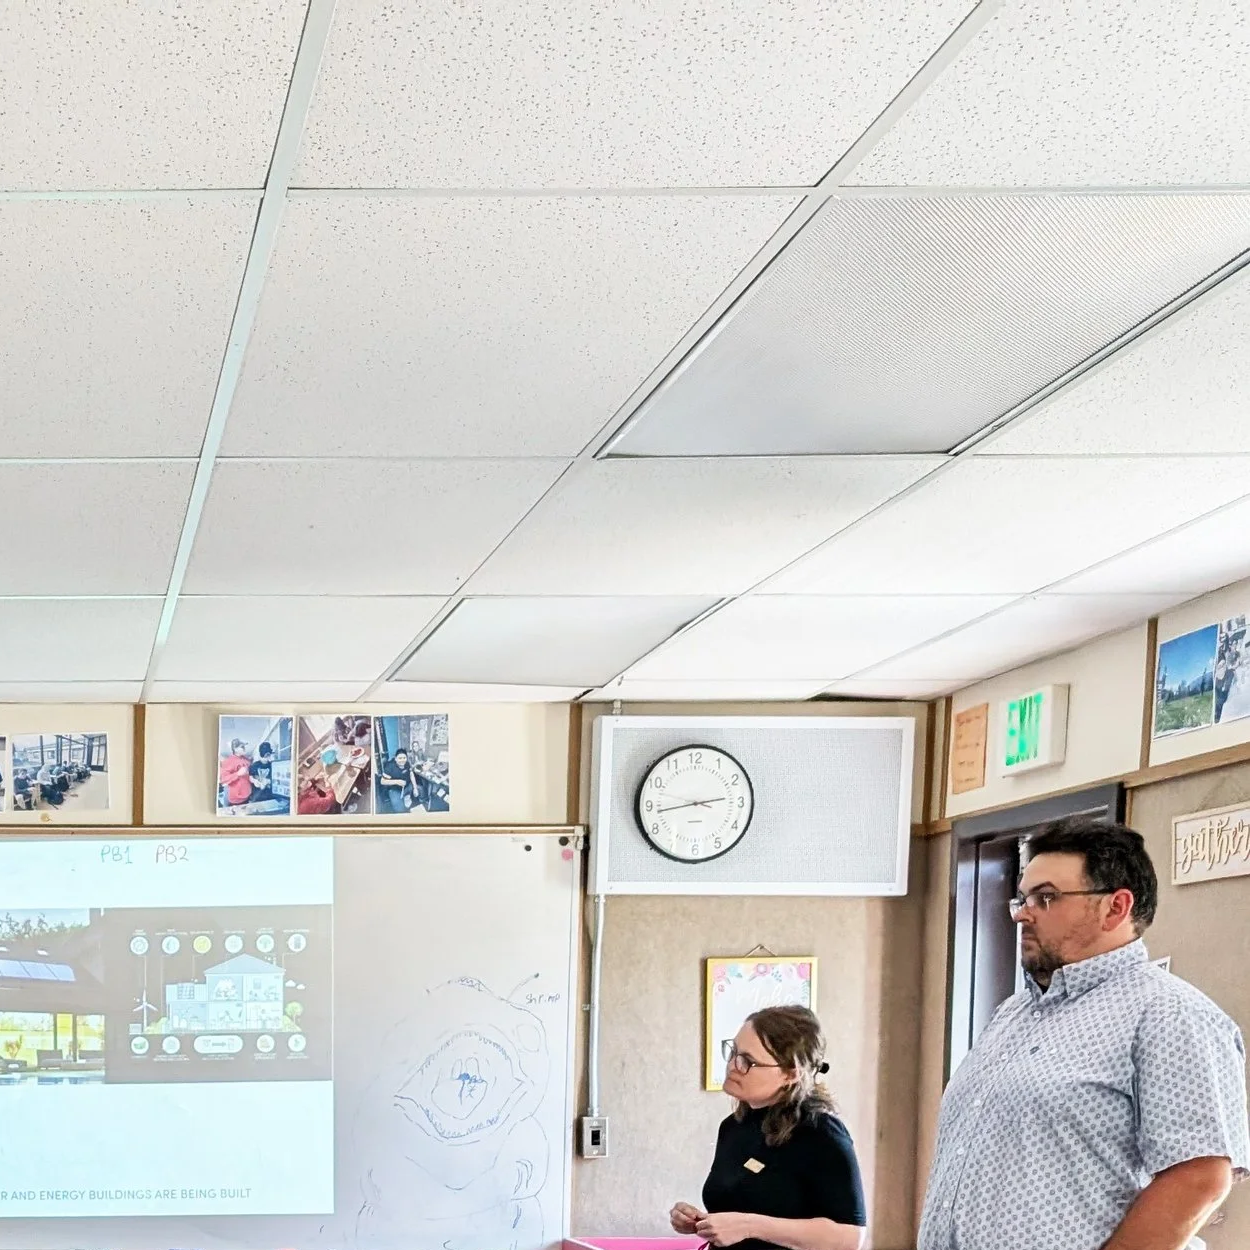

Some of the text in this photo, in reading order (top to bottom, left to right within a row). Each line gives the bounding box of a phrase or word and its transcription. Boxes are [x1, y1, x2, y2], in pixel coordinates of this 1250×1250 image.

[666, 758, 678, 770] 11
[688, 752, 703, 764] 12
[649, 777, 662, 789] 10
[731, 773, 739, 786] 2
[645, 800, 653, 812] 9
[737, 796, 745, 809] 3
[651, 822, 660, 835] 8
[731, 819, 739, 831] 4
[713, 836, 722, 849] 5
[101, 845, 189, 864] PB1 PB2
[691, 844, 699, 856] 6
[10, 1190, 37, 1201] AND
[39, 1189, 85, 1201] ENERGY
[88, 1188, 152, 1200] BUILDINGS
[154, 1188, 178, 1199] ARE
[180, 1188, 218, 1199] BEING
[220, 1187, 252, 1199] BUILT
